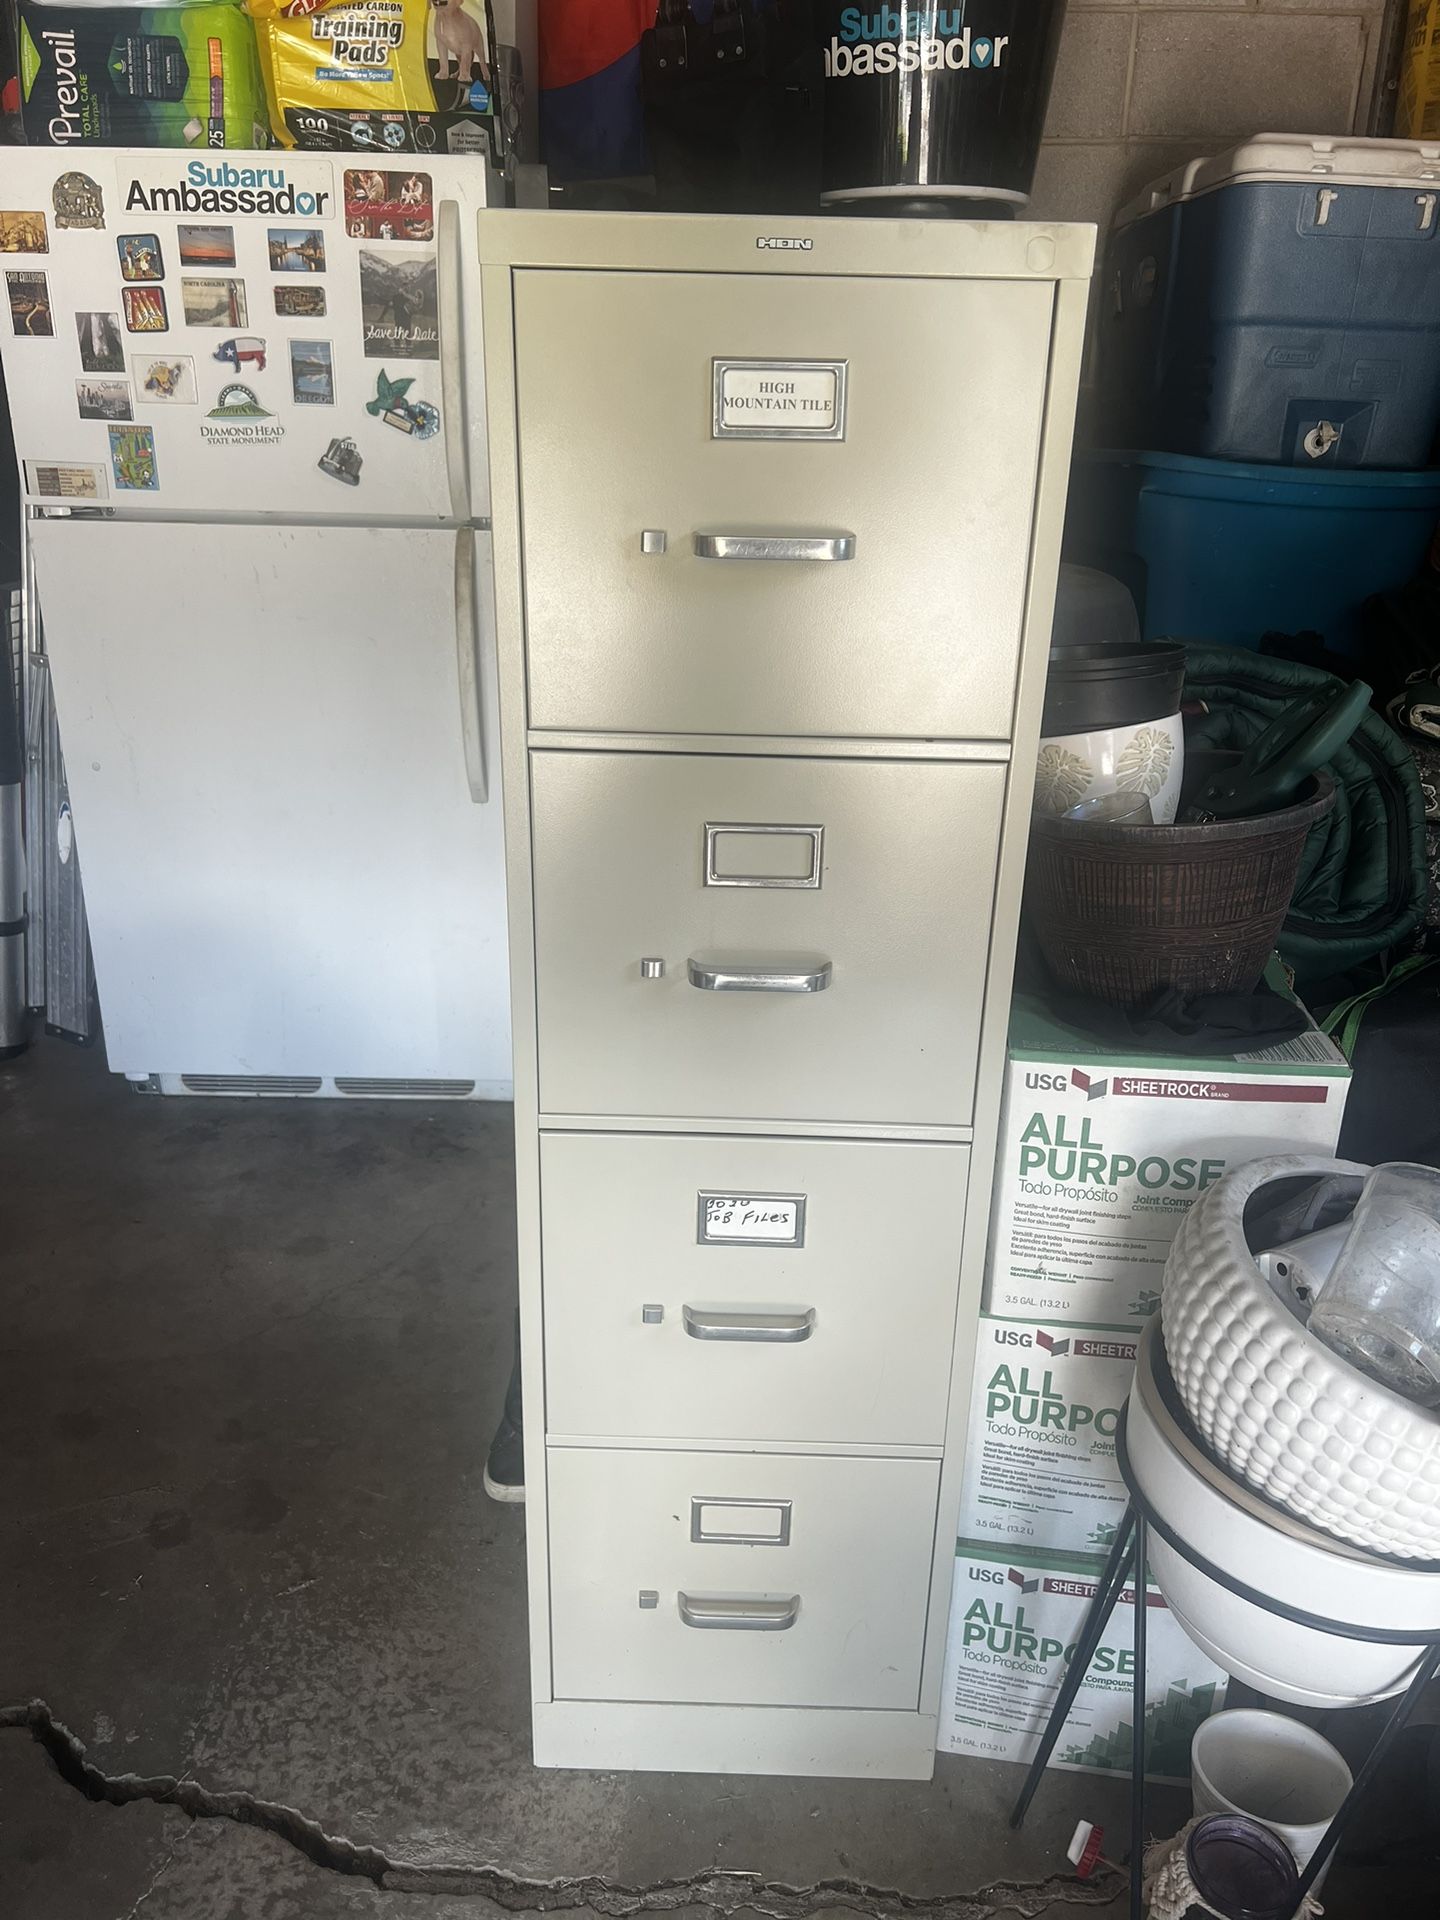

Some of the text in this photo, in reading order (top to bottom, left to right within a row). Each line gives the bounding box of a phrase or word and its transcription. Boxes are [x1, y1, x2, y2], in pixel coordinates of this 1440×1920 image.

[366, 2, 403, 12] CARBON
[312, 14, 402, 44] Training
[334, 40, 386, 63] Pads
[82, 105, 91, 137] TOTAL
[91, 93, 100, 138] Underpads
[297, 117, 329, 131] 100
[209, 130, 224, 148] 25
[188, 161, 285, 188] Subaru
[126, 180, 329, 215] Ambassador
[757, 237, 813, 250] HON
[759, 382, 795, 394] HIGH
[724, 397, 832, 411] MOUNTAIN TILE
[200, 426, 285, 437] DIAMOND HEAD
[207, 437, 280, 445] STATE MONUMENT
[1025, 1072, 1067, 1092] USG
[1020, 1112, 1104, 1151] ALL
[1018, 1179, 1119, 1203] Todo Propósito
[1133, 1195, 1161, 1205] Joint
[1005, 1295, 1018, 1304] 3.5
[1040, 1299, 1060, 1308] (13.2
[995, 1329, 1032, 1348] USG
[987, 1363, 1063, 1400] ALL
[985, 1419, 1077, 1447] Todo Propósito
[975, 1519, 987, 1528] 3.5
[1007, 1524, 1026, 1535] (13.2
[969, 1567, 1004, 1585] USG
[964, 1599, 1035, 1634] ALL
[962, 1648, 1048, 1676] Todo Propósito
